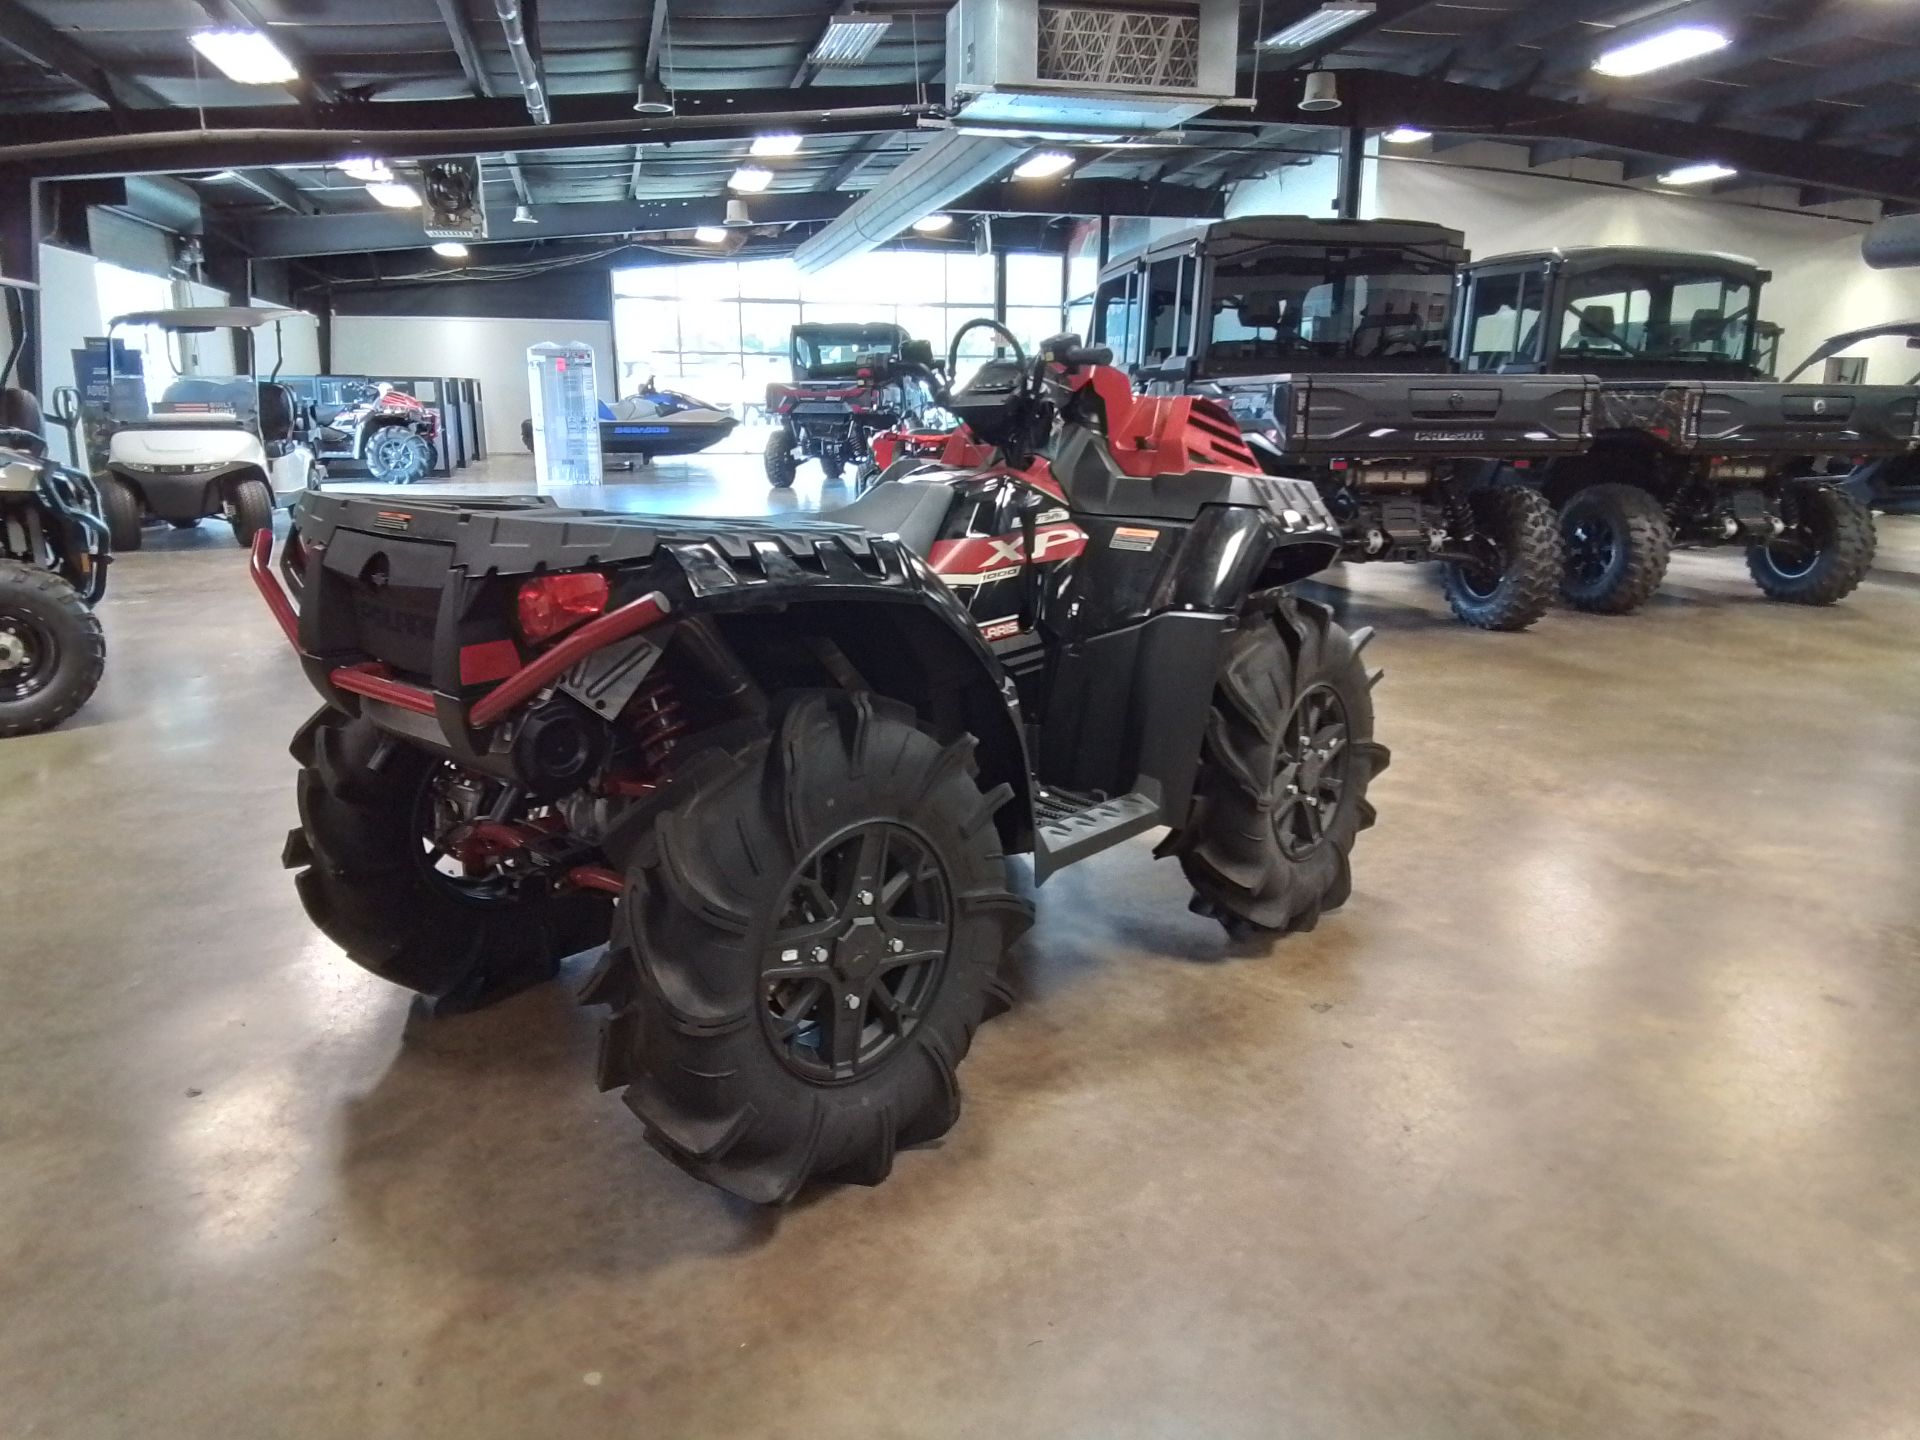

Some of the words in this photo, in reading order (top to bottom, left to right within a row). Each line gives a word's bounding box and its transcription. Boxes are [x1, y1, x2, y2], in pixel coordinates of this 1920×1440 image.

[979, 529, 1085, 569] XP
[982, 567, 1018, 581] 1000
[980, 622, 1019, 639] LARIS
